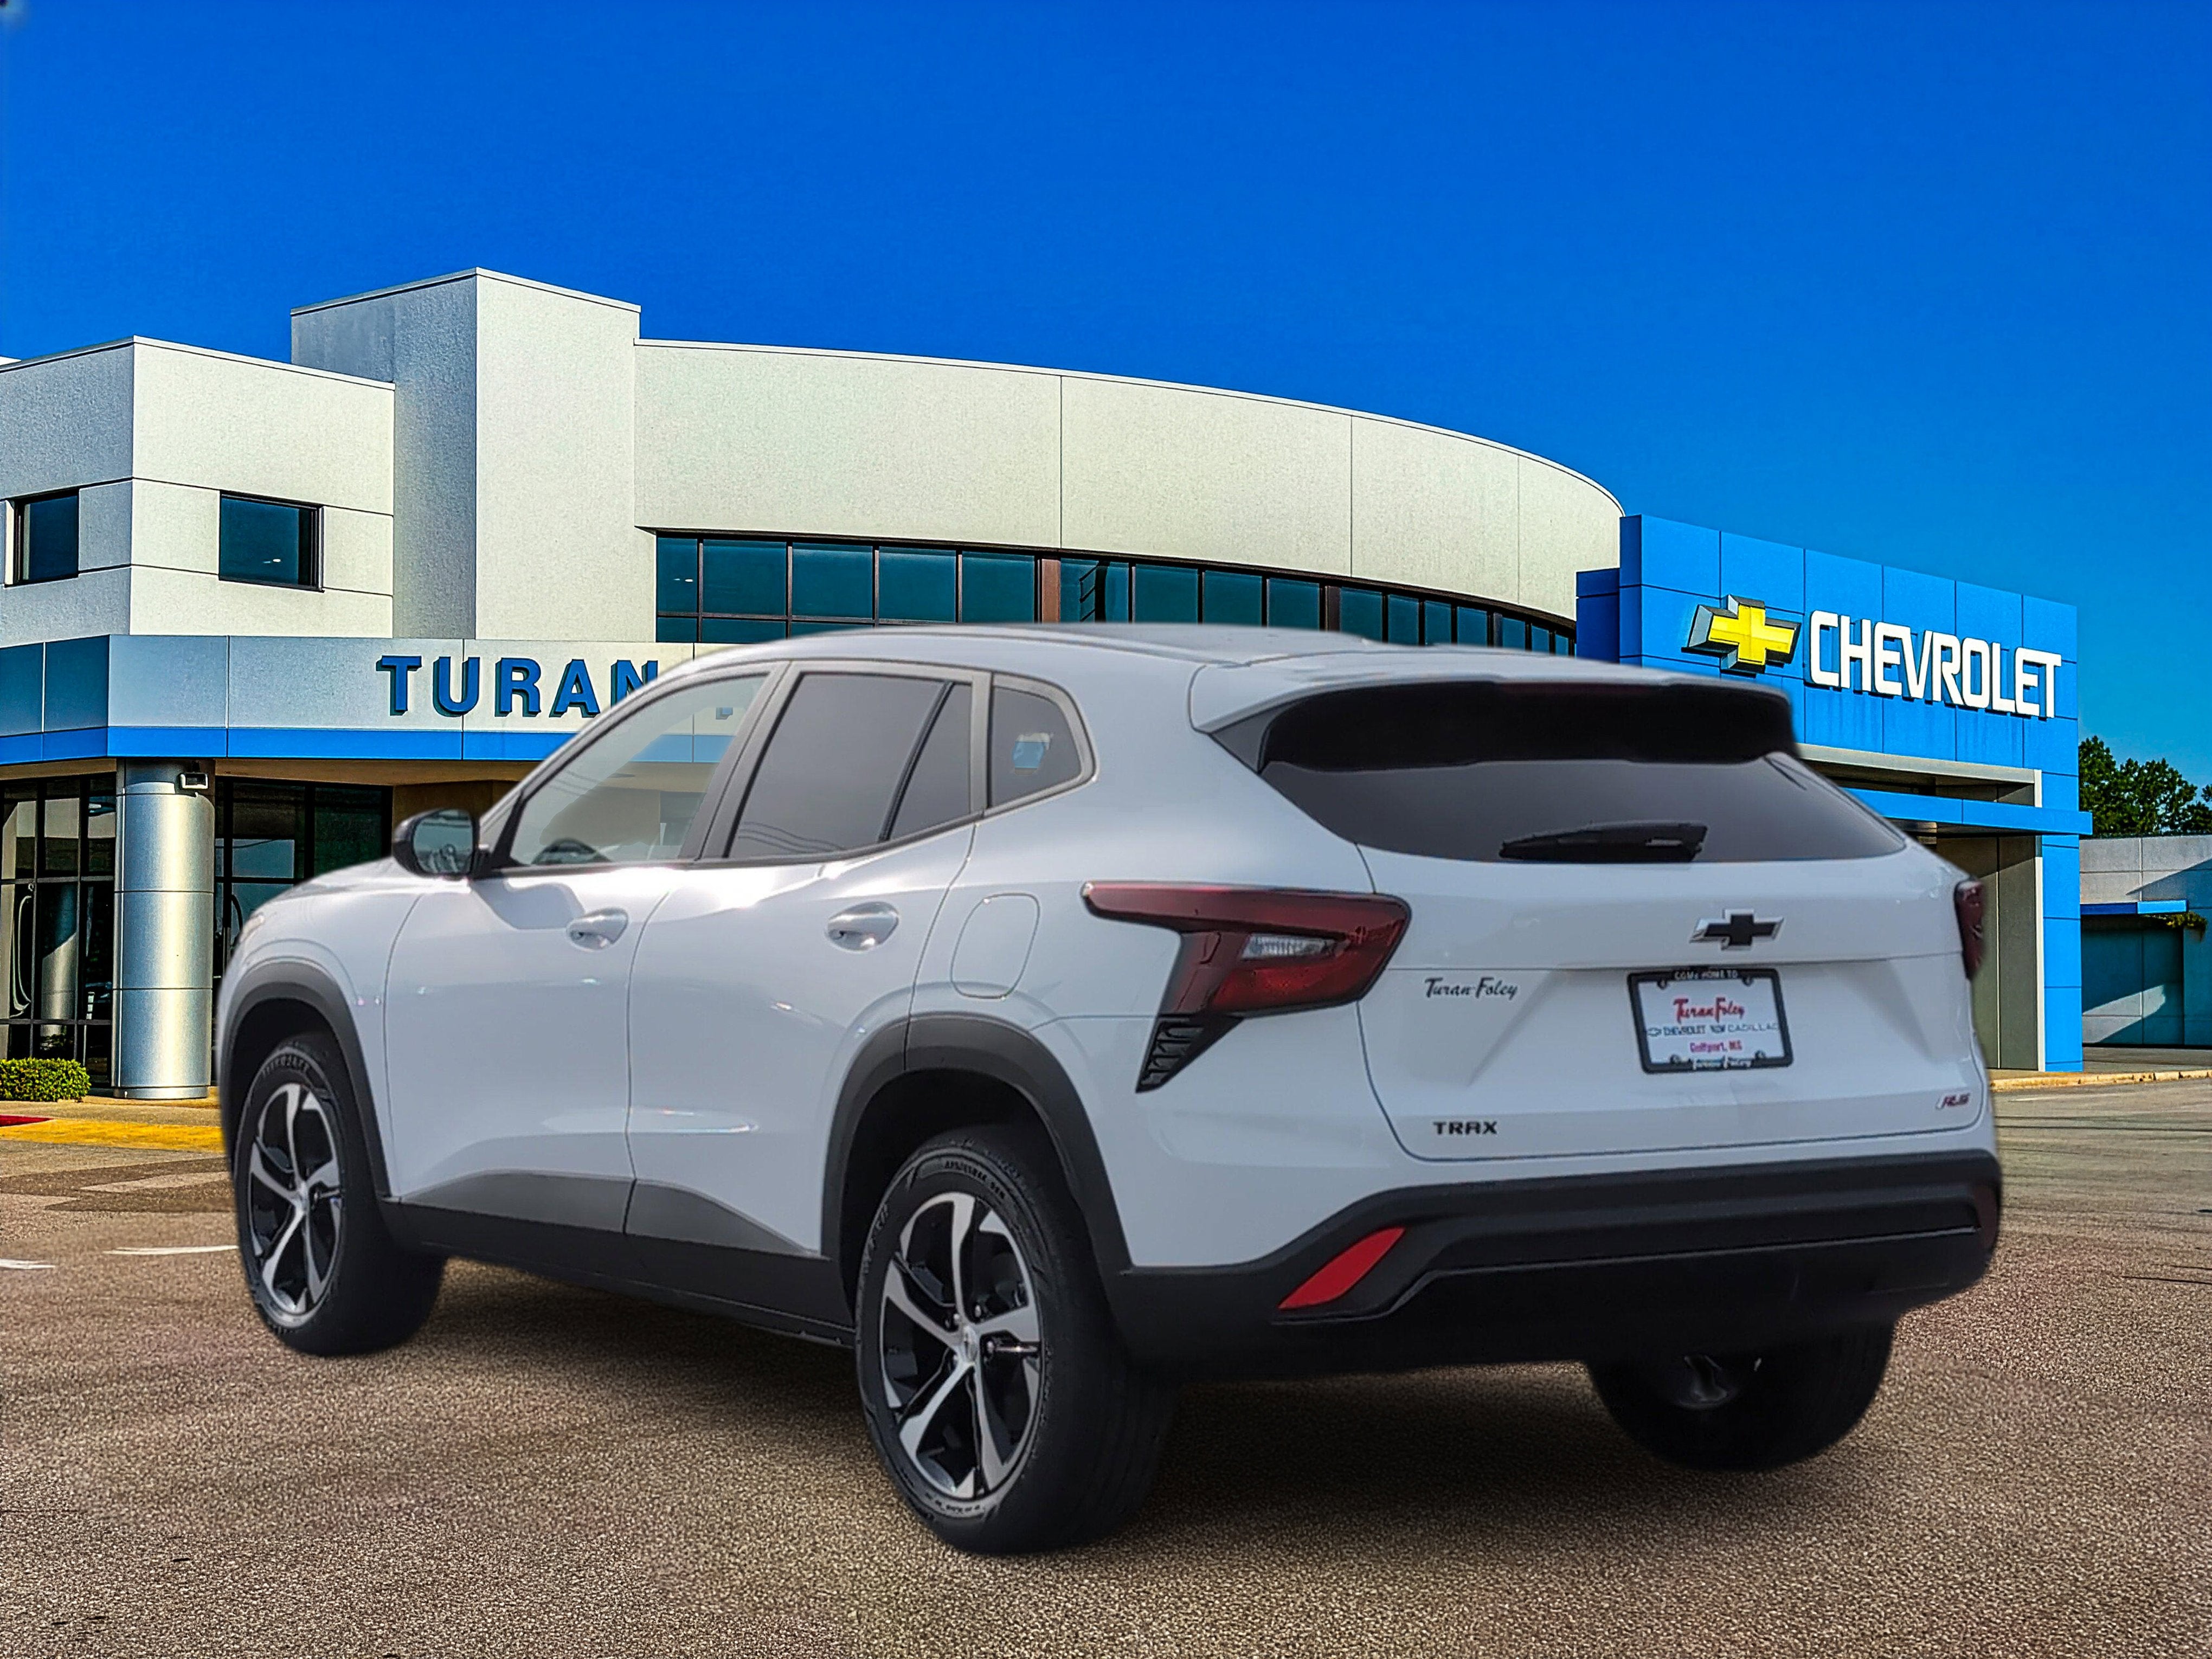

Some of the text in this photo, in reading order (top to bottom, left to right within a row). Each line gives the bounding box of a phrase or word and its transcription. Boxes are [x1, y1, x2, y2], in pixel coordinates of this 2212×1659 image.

[376, 655, 659, 718] TURAN
[1810, 610, 2062, 718] CHEVROLET
[1432, 1121, 1497, 1135] TRAX
